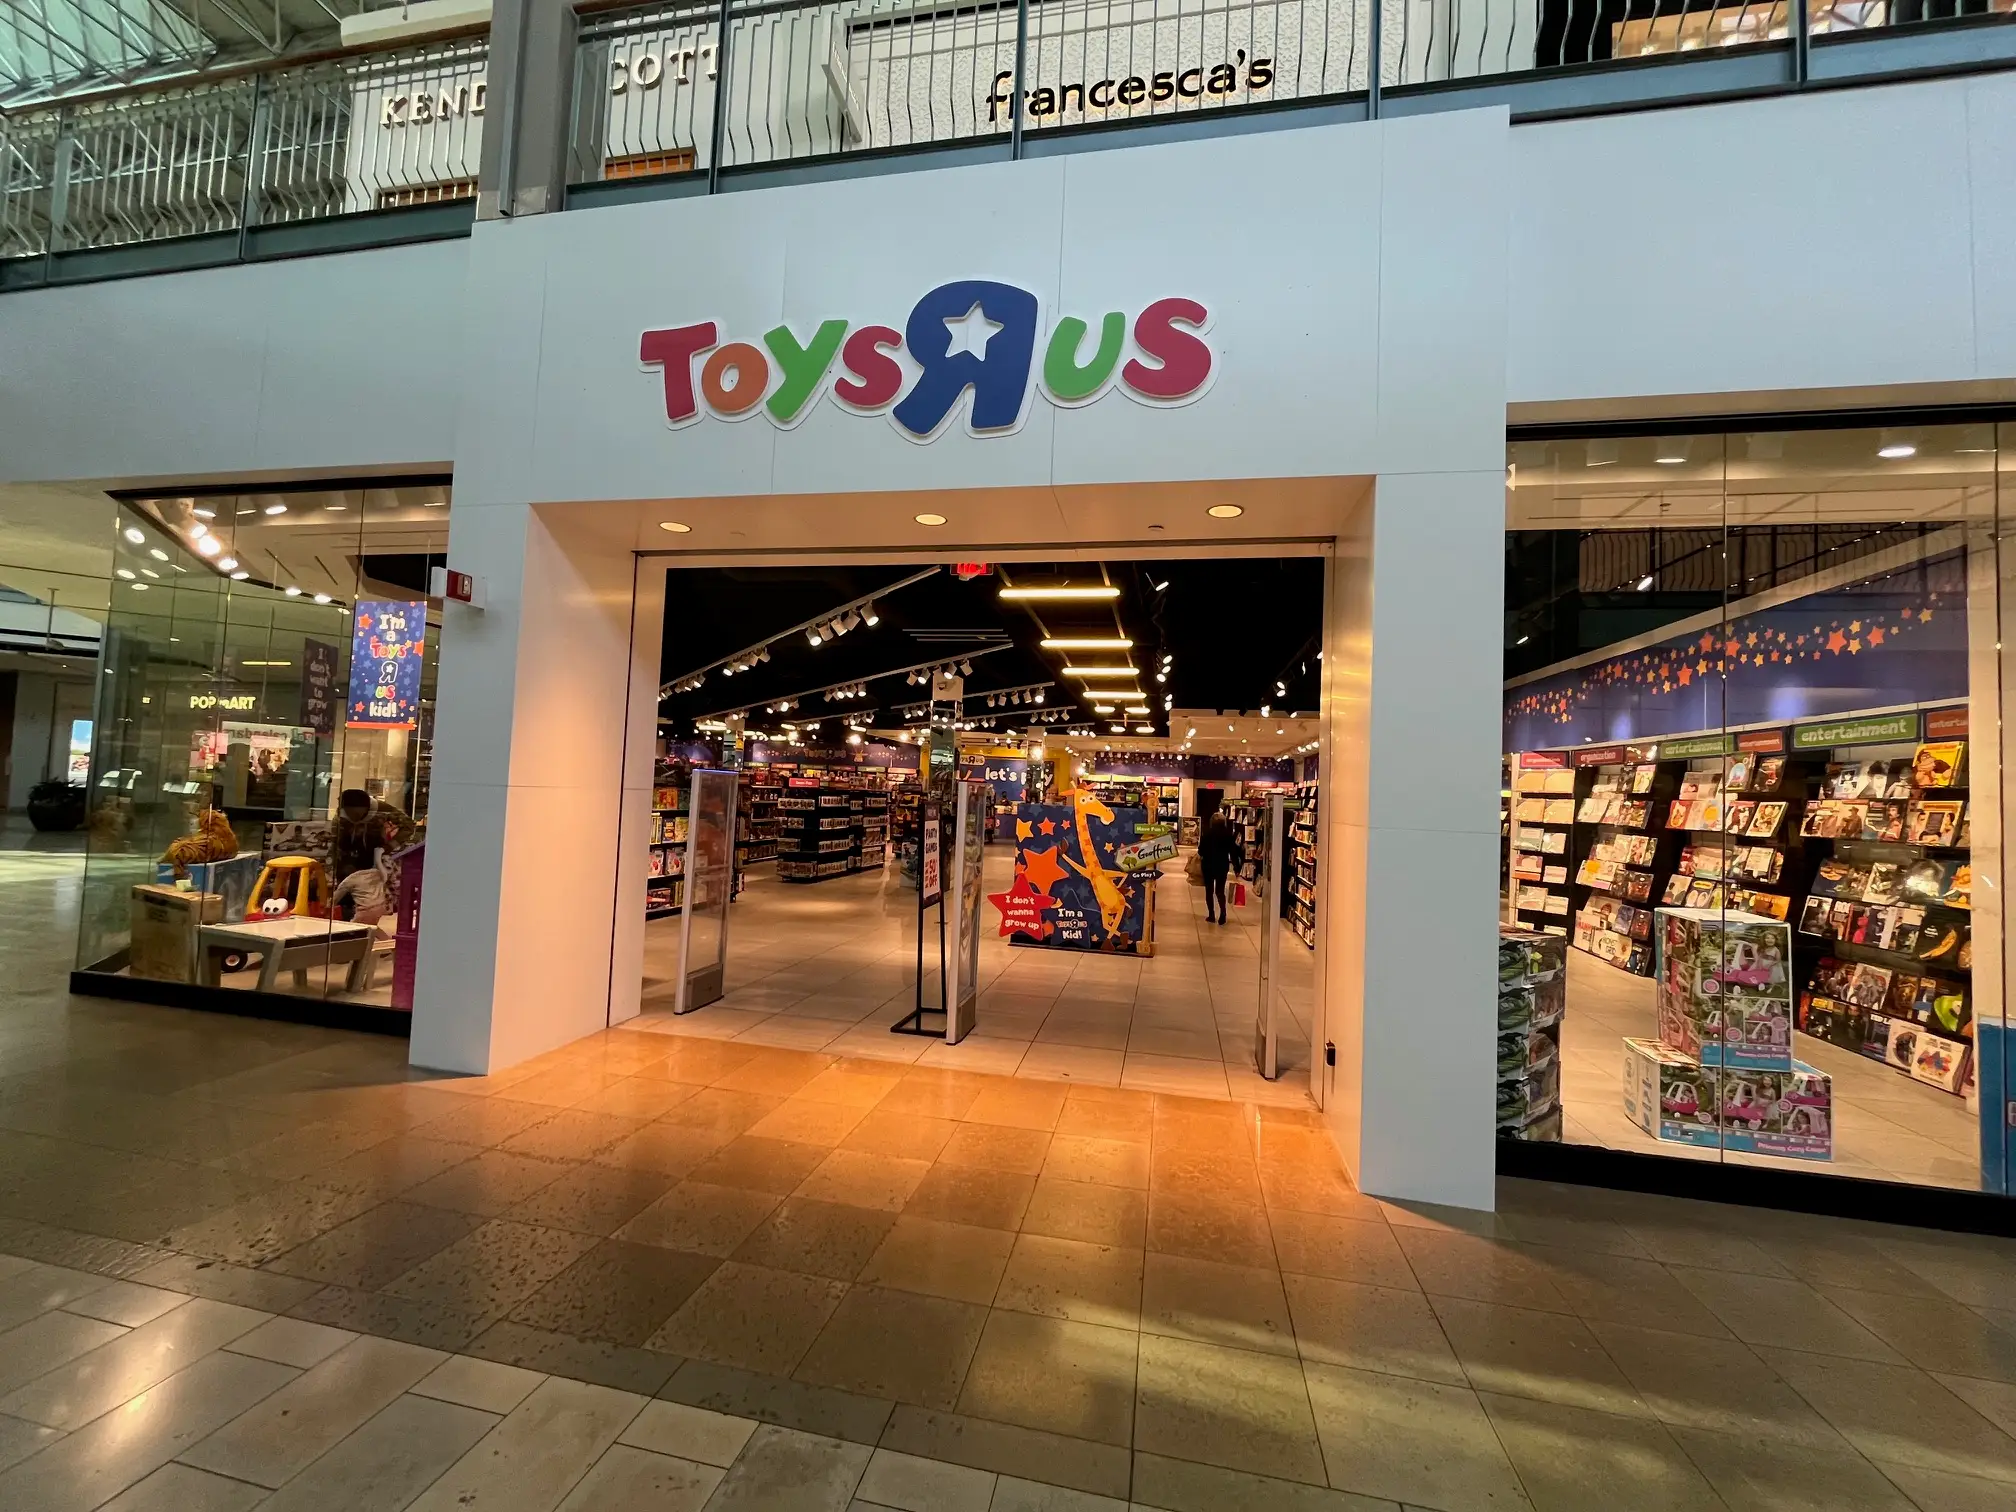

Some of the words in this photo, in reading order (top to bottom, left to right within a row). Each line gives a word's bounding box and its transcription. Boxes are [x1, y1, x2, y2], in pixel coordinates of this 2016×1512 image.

[985, 47, 1275, 123] francesca's
[378, 613, 406, 631] I'm
[385, 630, 396, 642] a
[189, 695, 217, 710] POP
[369, 701, 397, 718] kid!
[1801, 718, 1907, 742] entertainment
[985, 767, 1017, 781] let's
[1137, 843, 1173, 860] Geoffrey
[1012, 896, 1035, 905] don't
[1057, 908, 1075, 917] I'm
[1004, 919, 1027, 928] grow
[1027, 922, 1040, 931] up
[1062, 930, 1083, 940] Kid!
